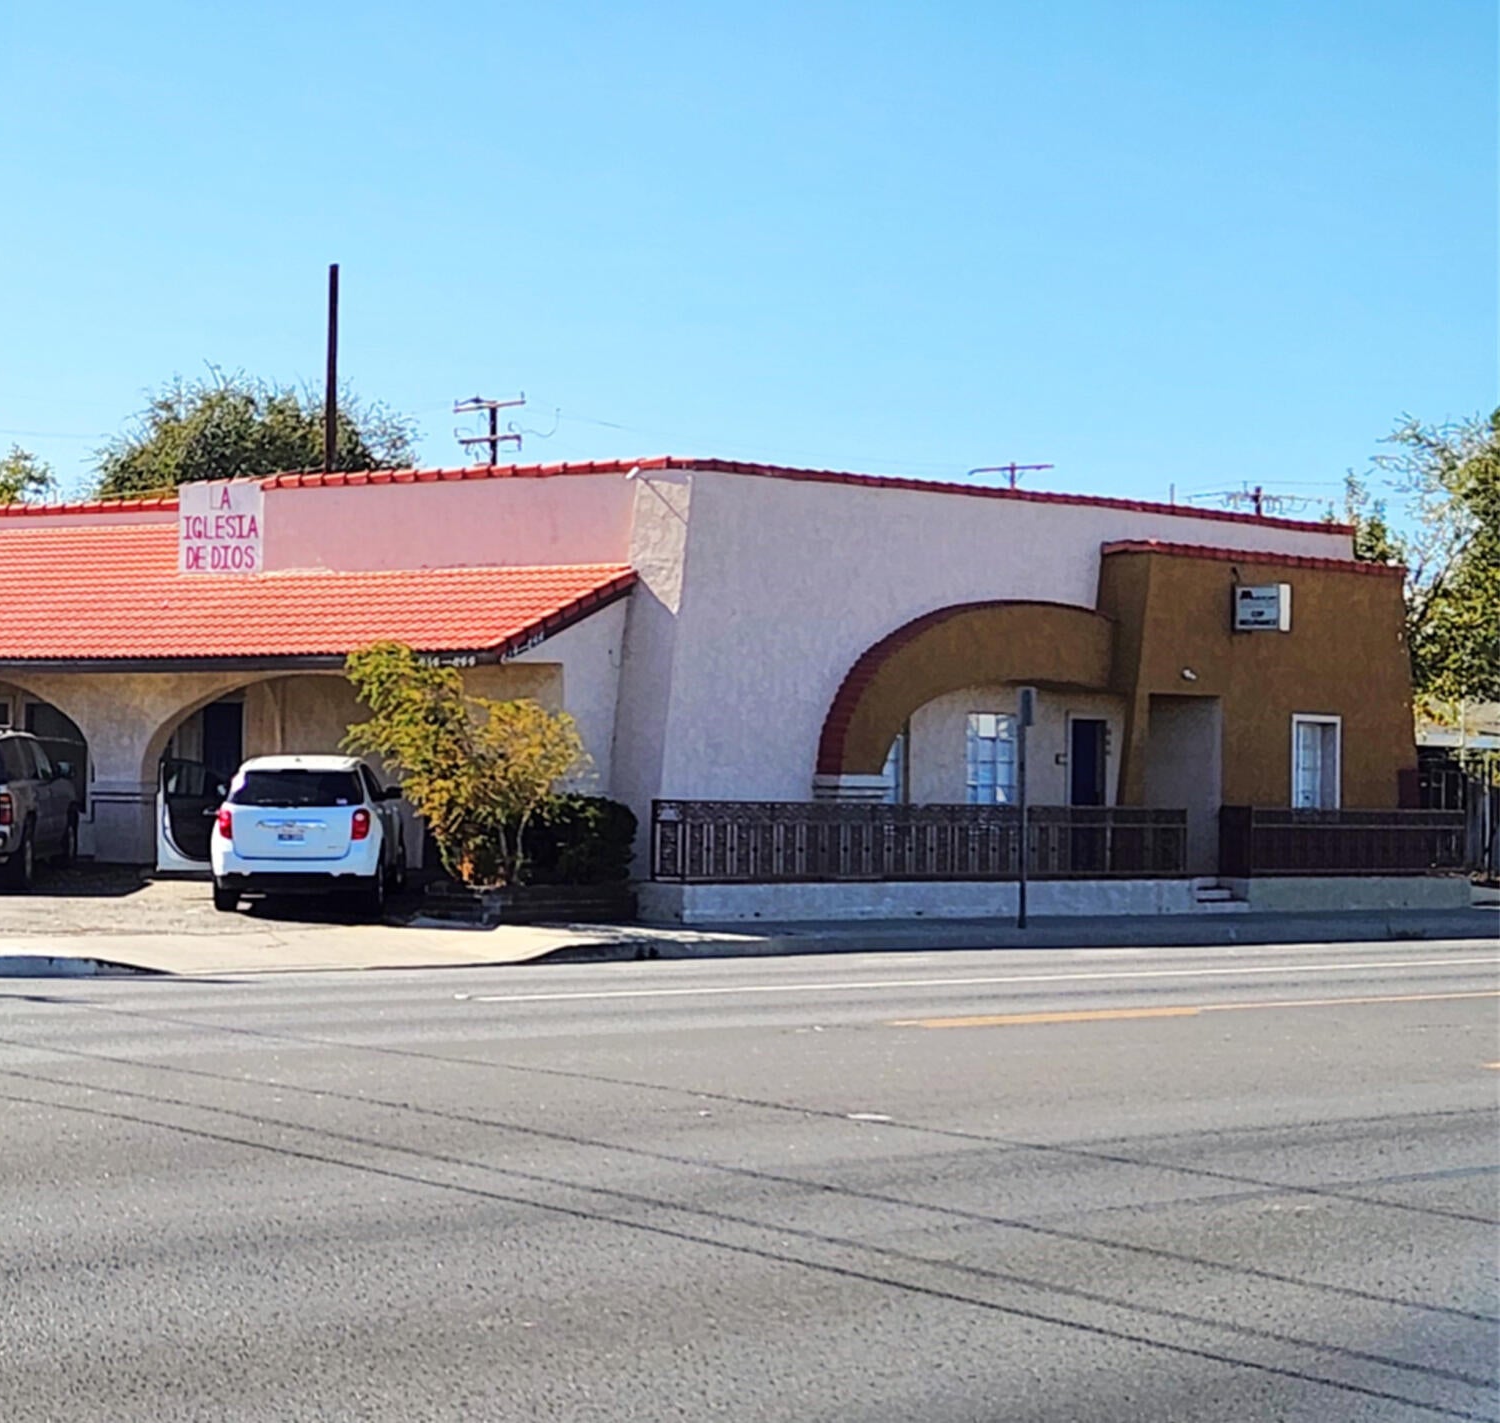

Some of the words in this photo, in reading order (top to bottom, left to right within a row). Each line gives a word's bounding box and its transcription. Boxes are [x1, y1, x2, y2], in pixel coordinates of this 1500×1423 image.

[183, 514, 259, 539] IGLESIA
[186, 545, 206, 570] DE
[211, 545, 255, 570] DIOS
